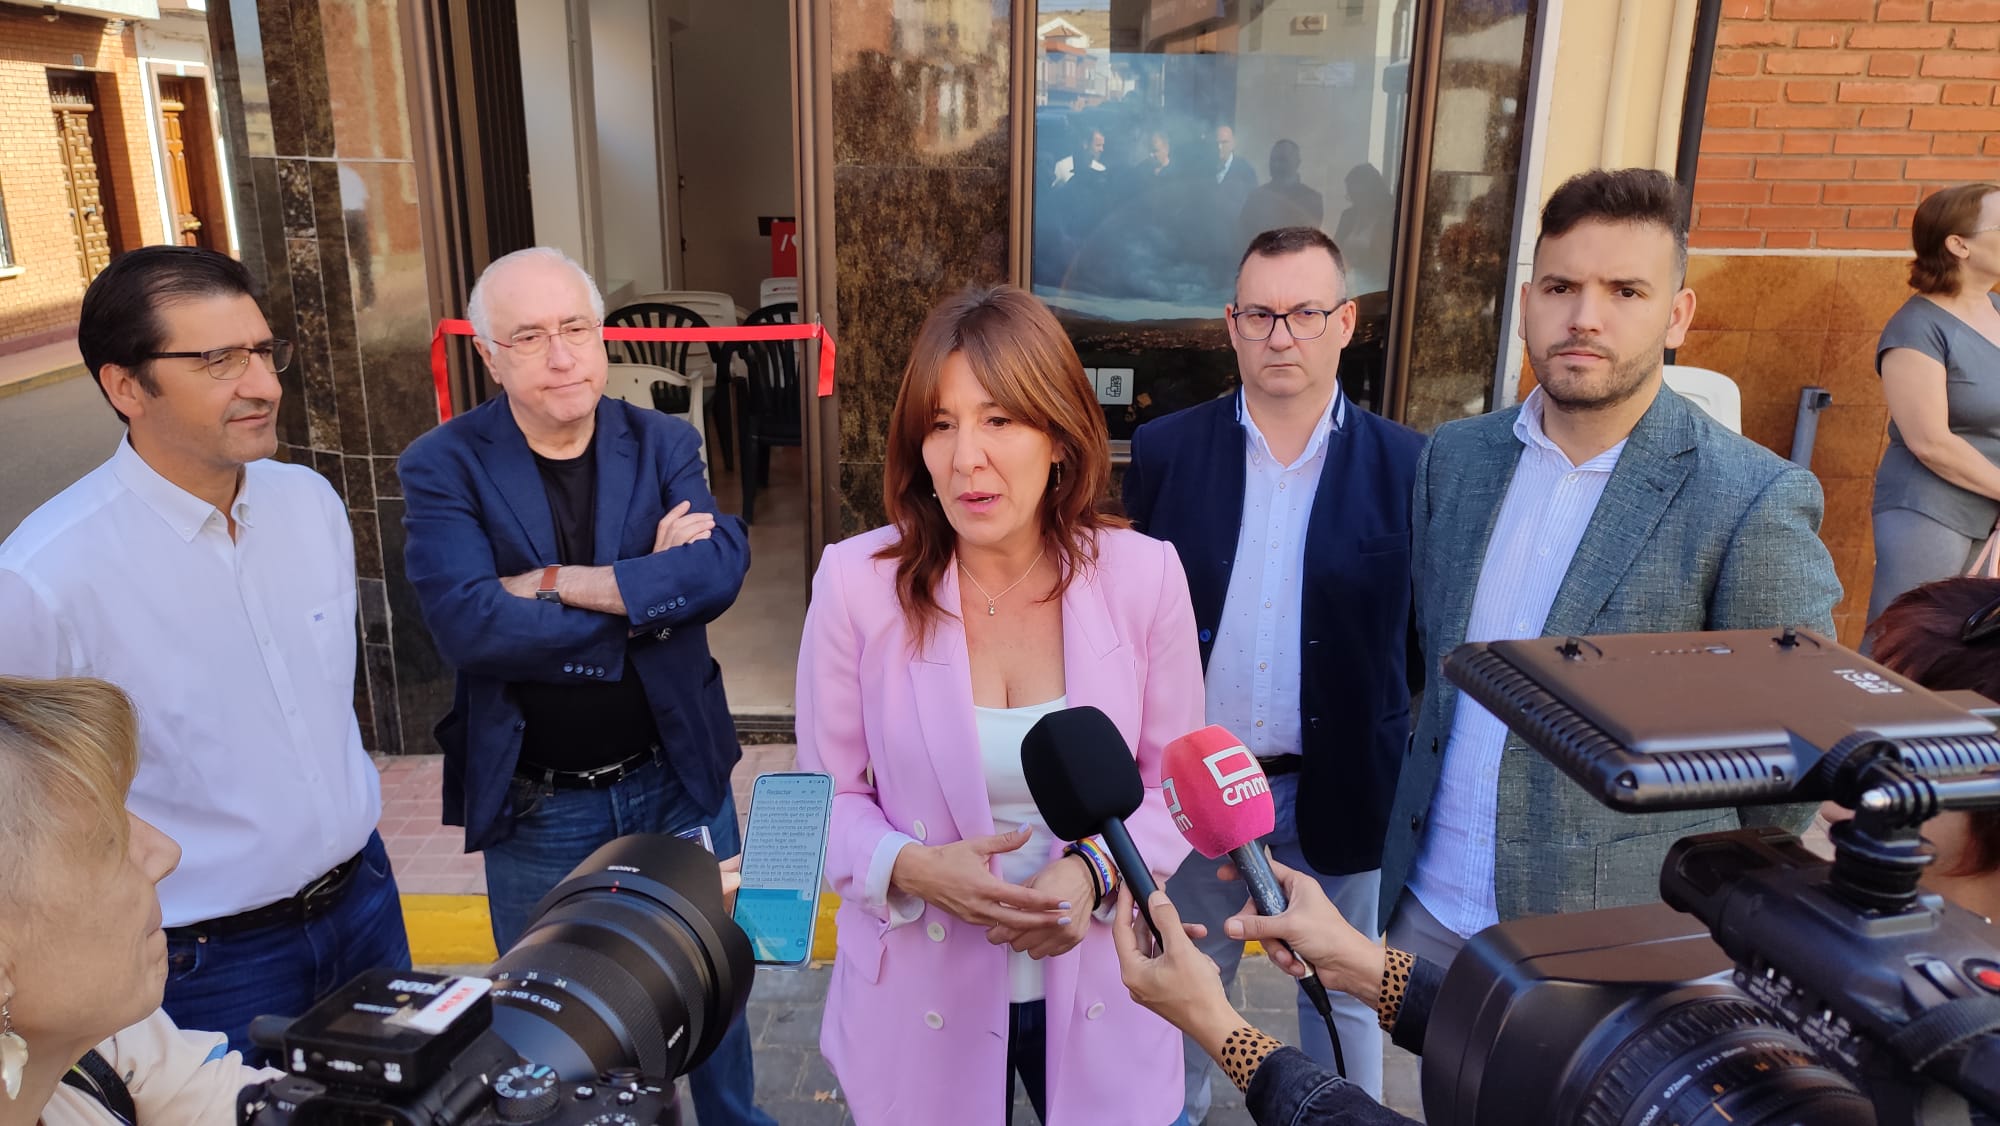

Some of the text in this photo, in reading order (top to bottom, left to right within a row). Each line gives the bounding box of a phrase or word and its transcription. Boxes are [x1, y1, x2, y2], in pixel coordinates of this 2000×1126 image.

[1222, 776, 1270, 807] cmm
[530, 994, 541, 1003] G
[540, 998, 562, 1013] OSS
